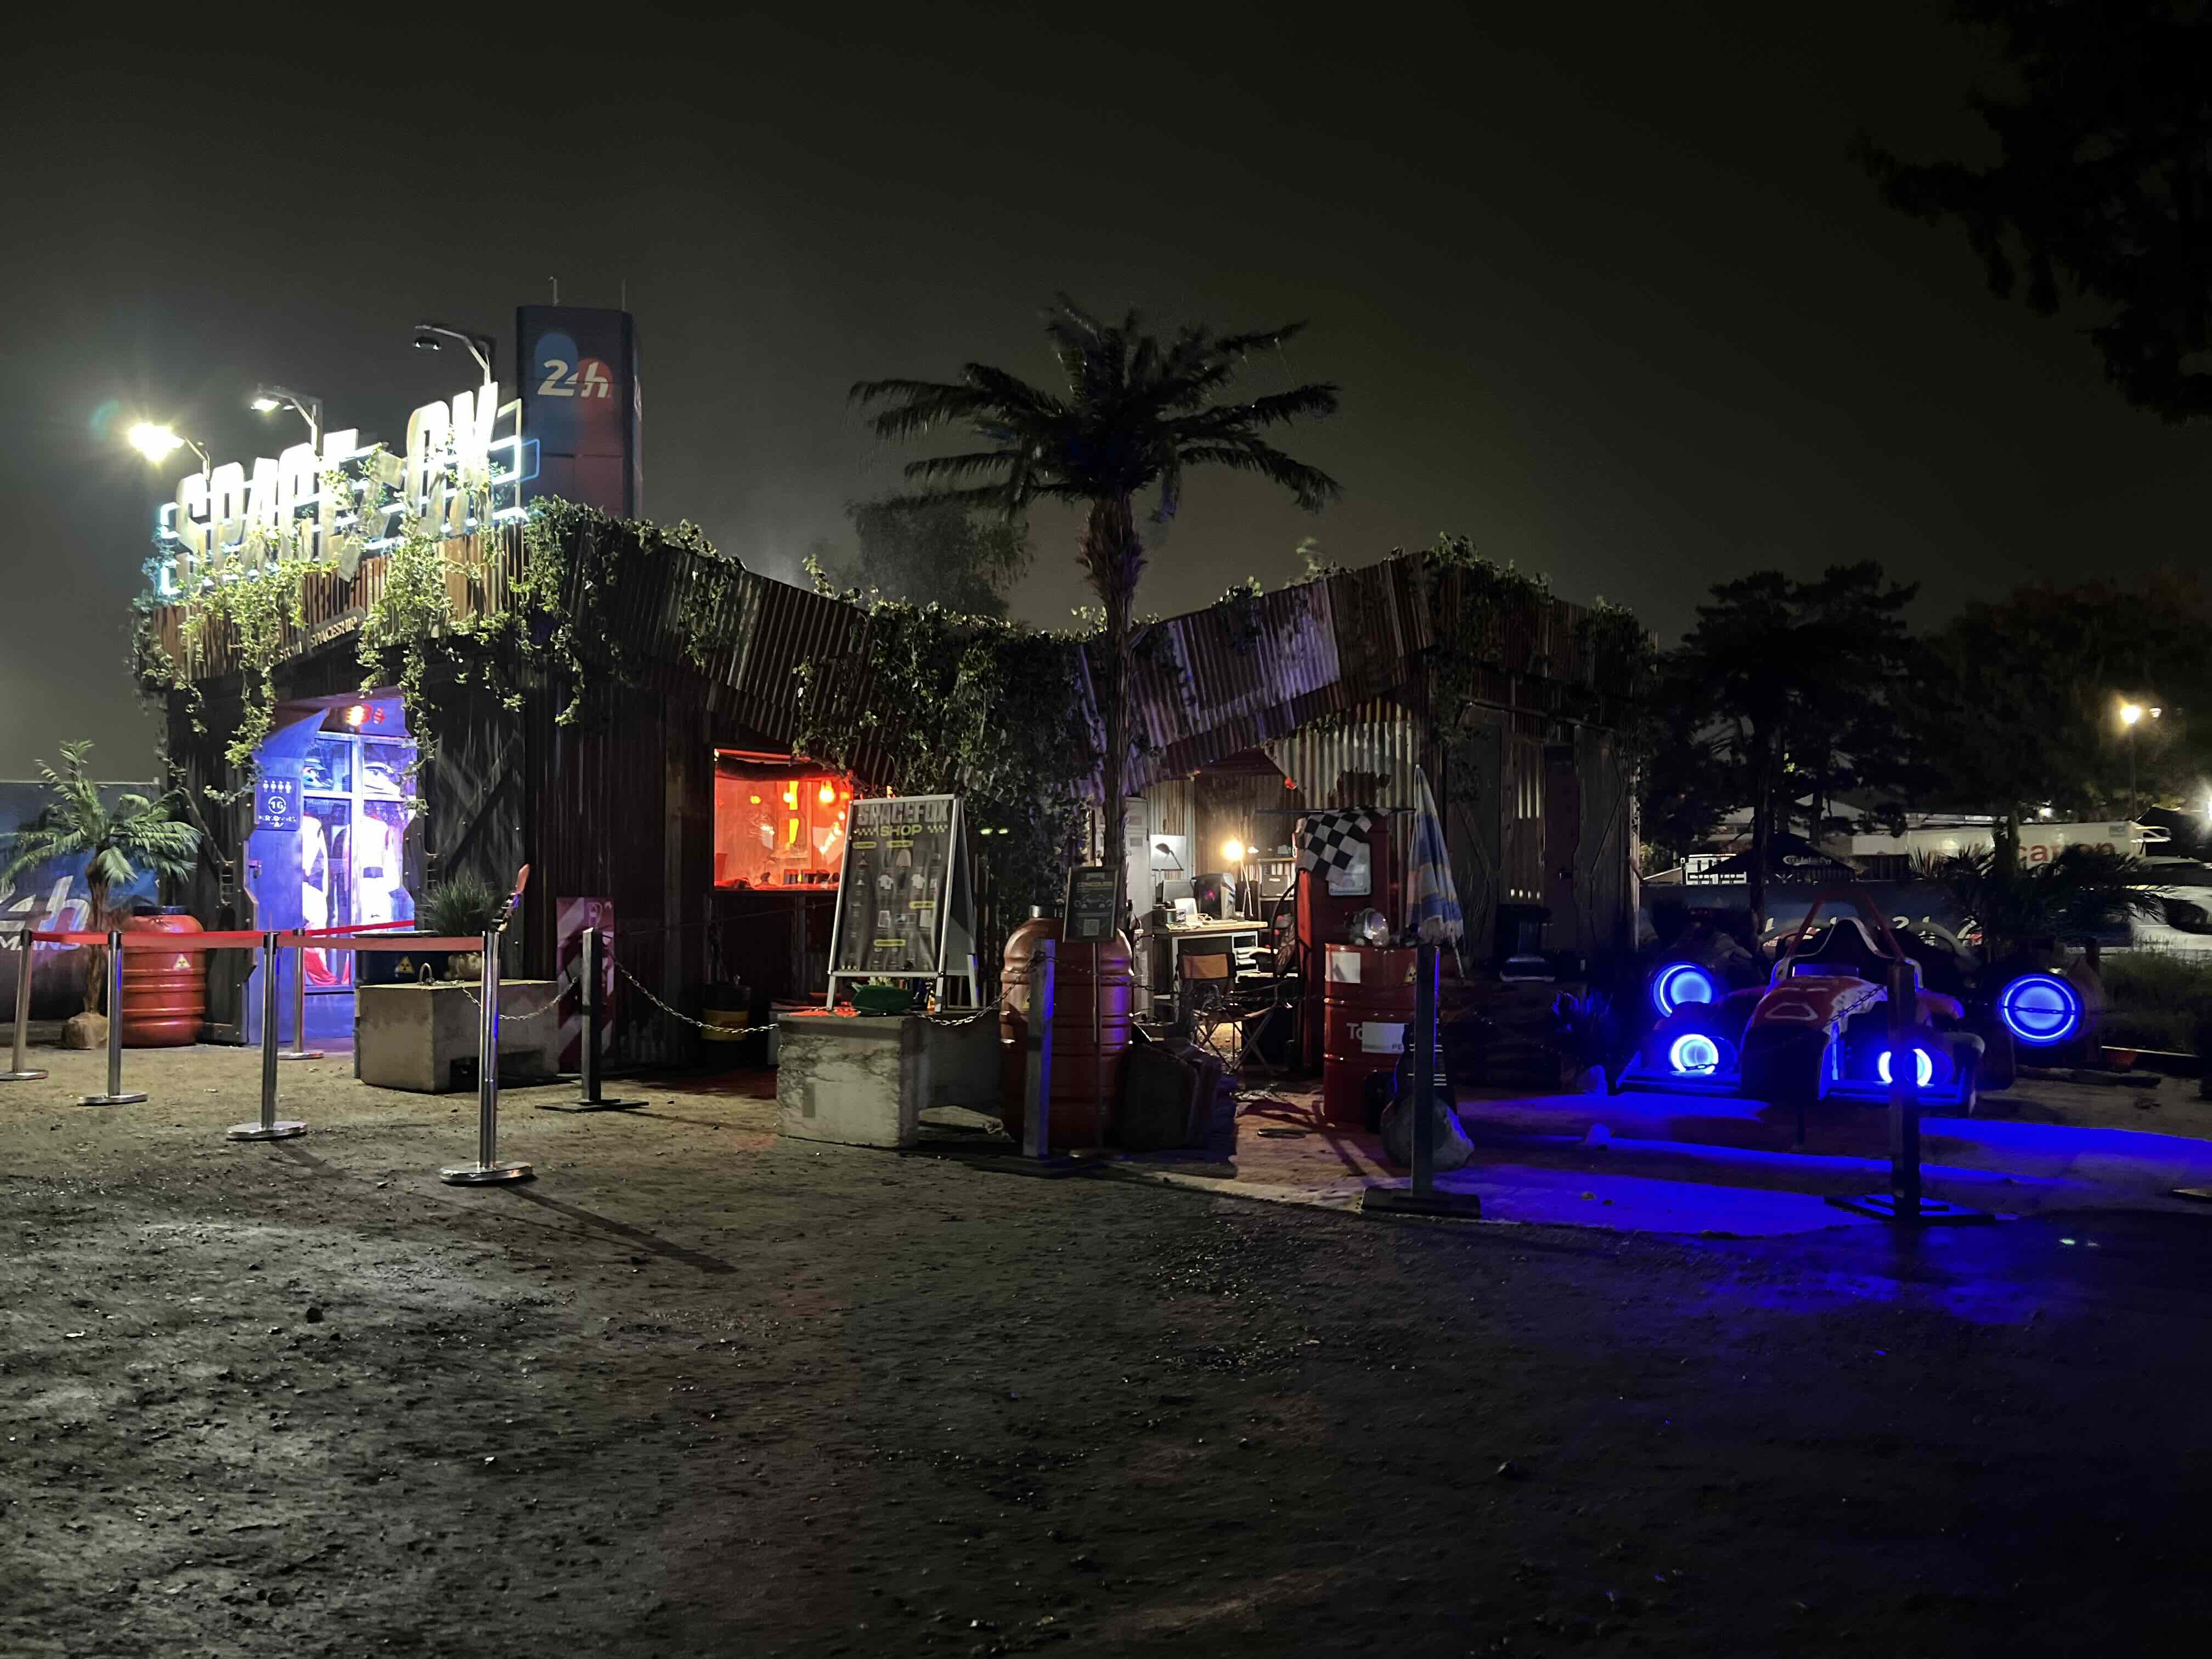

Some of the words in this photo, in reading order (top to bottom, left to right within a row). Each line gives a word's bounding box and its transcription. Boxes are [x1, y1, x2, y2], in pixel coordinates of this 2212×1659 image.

[538, 359, 608, 398] 24h
[857, 801, 949, 825] SPACEFOX
[880, 825, 922, 837] SHOP
